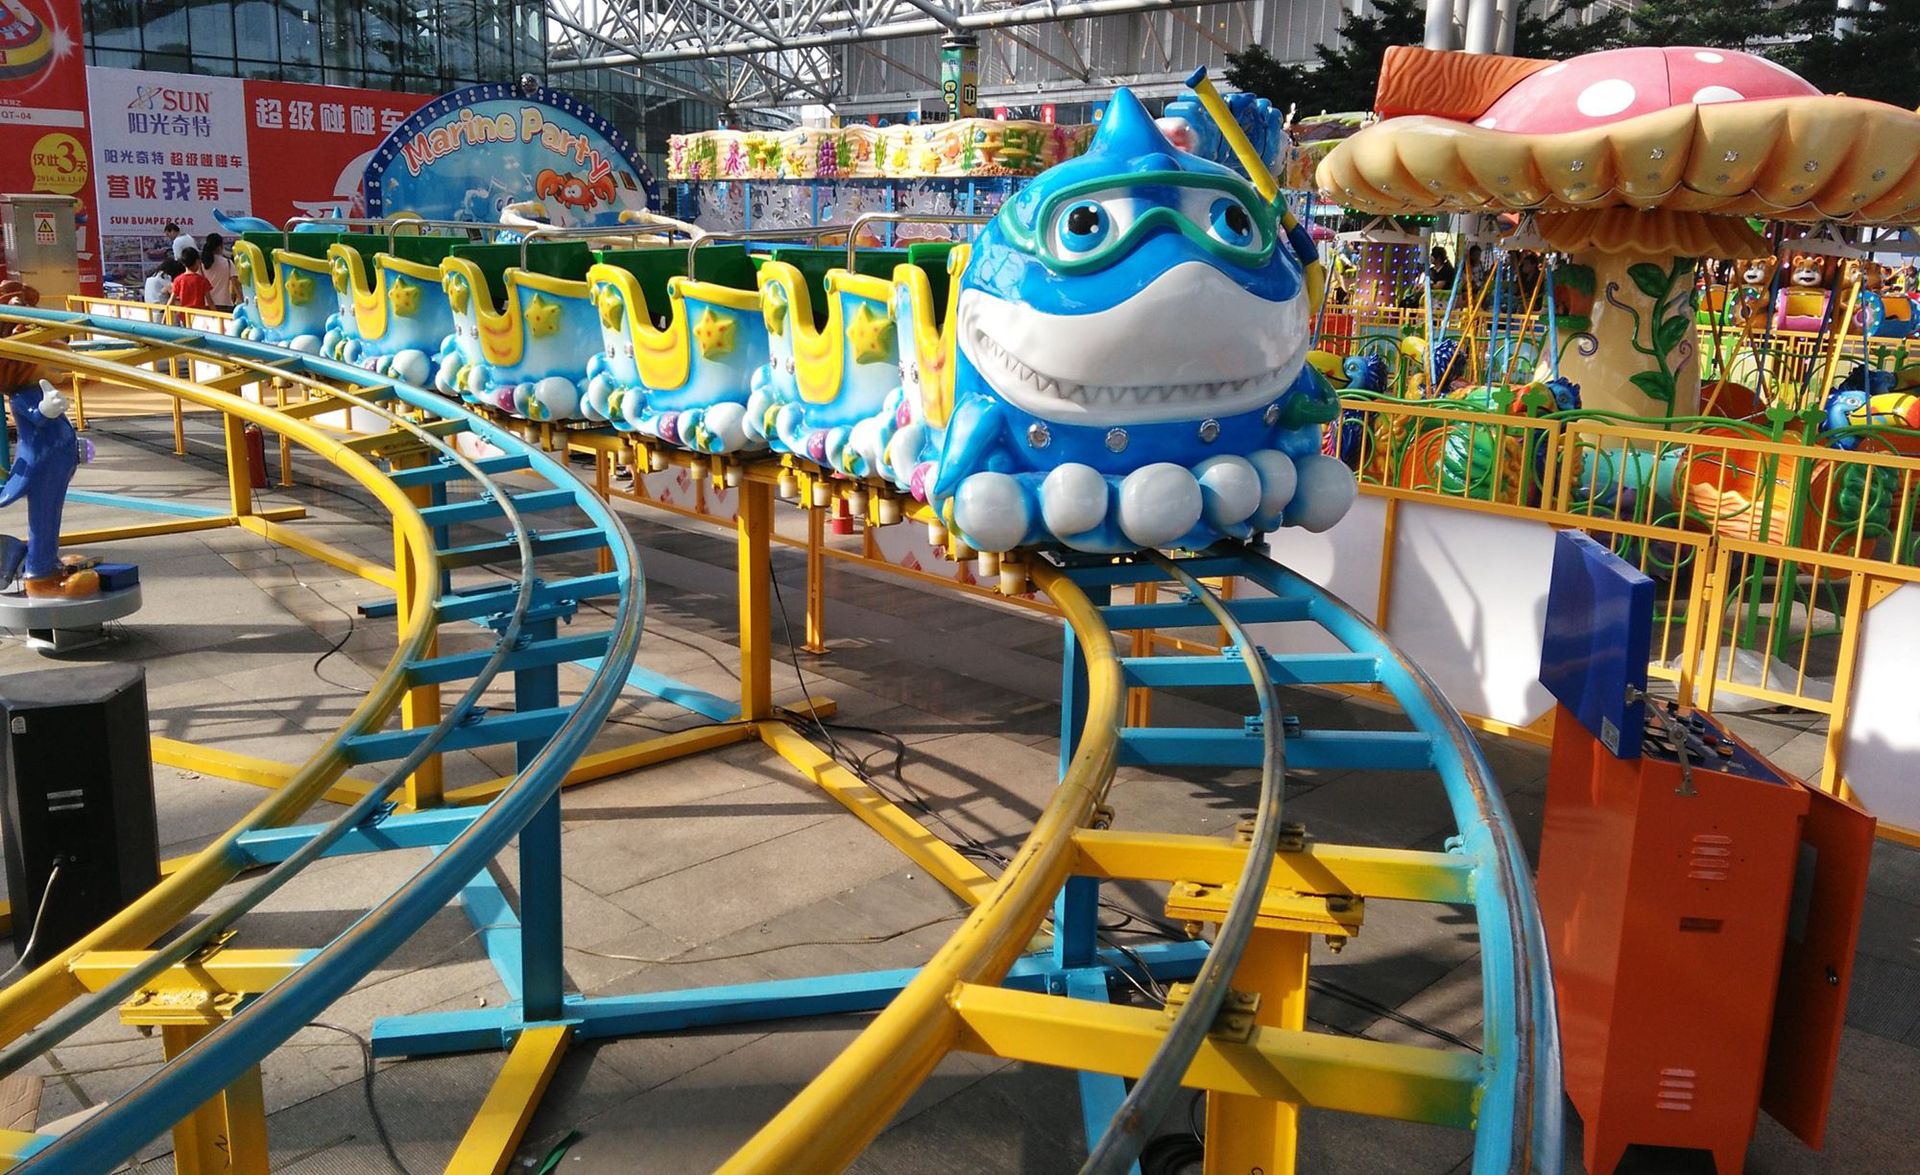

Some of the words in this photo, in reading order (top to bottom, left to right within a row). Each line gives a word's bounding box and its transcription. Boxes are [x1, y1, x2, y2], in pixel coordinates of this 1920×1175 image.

[162, 88, 210, 113] SUN
[127, 112, 211, 138] 阳光奇特
[255, 97, 406, 135] 超级碰碰车
[33, 141, 88, 174] 仅此3天
[104, 149, 164, 165] 阳光奇特
[170, 151, 242, 168] 超级碰碰车
[400, 108, 517, 177] Marine
[520, 107, 613, 184] Party
[107, 171, 244, 201] 营收我第一
[110, 216, 128, 225] SUN
[131, 216, 171, 225] BUMPER
[174, 216, 194, 226] CAR
